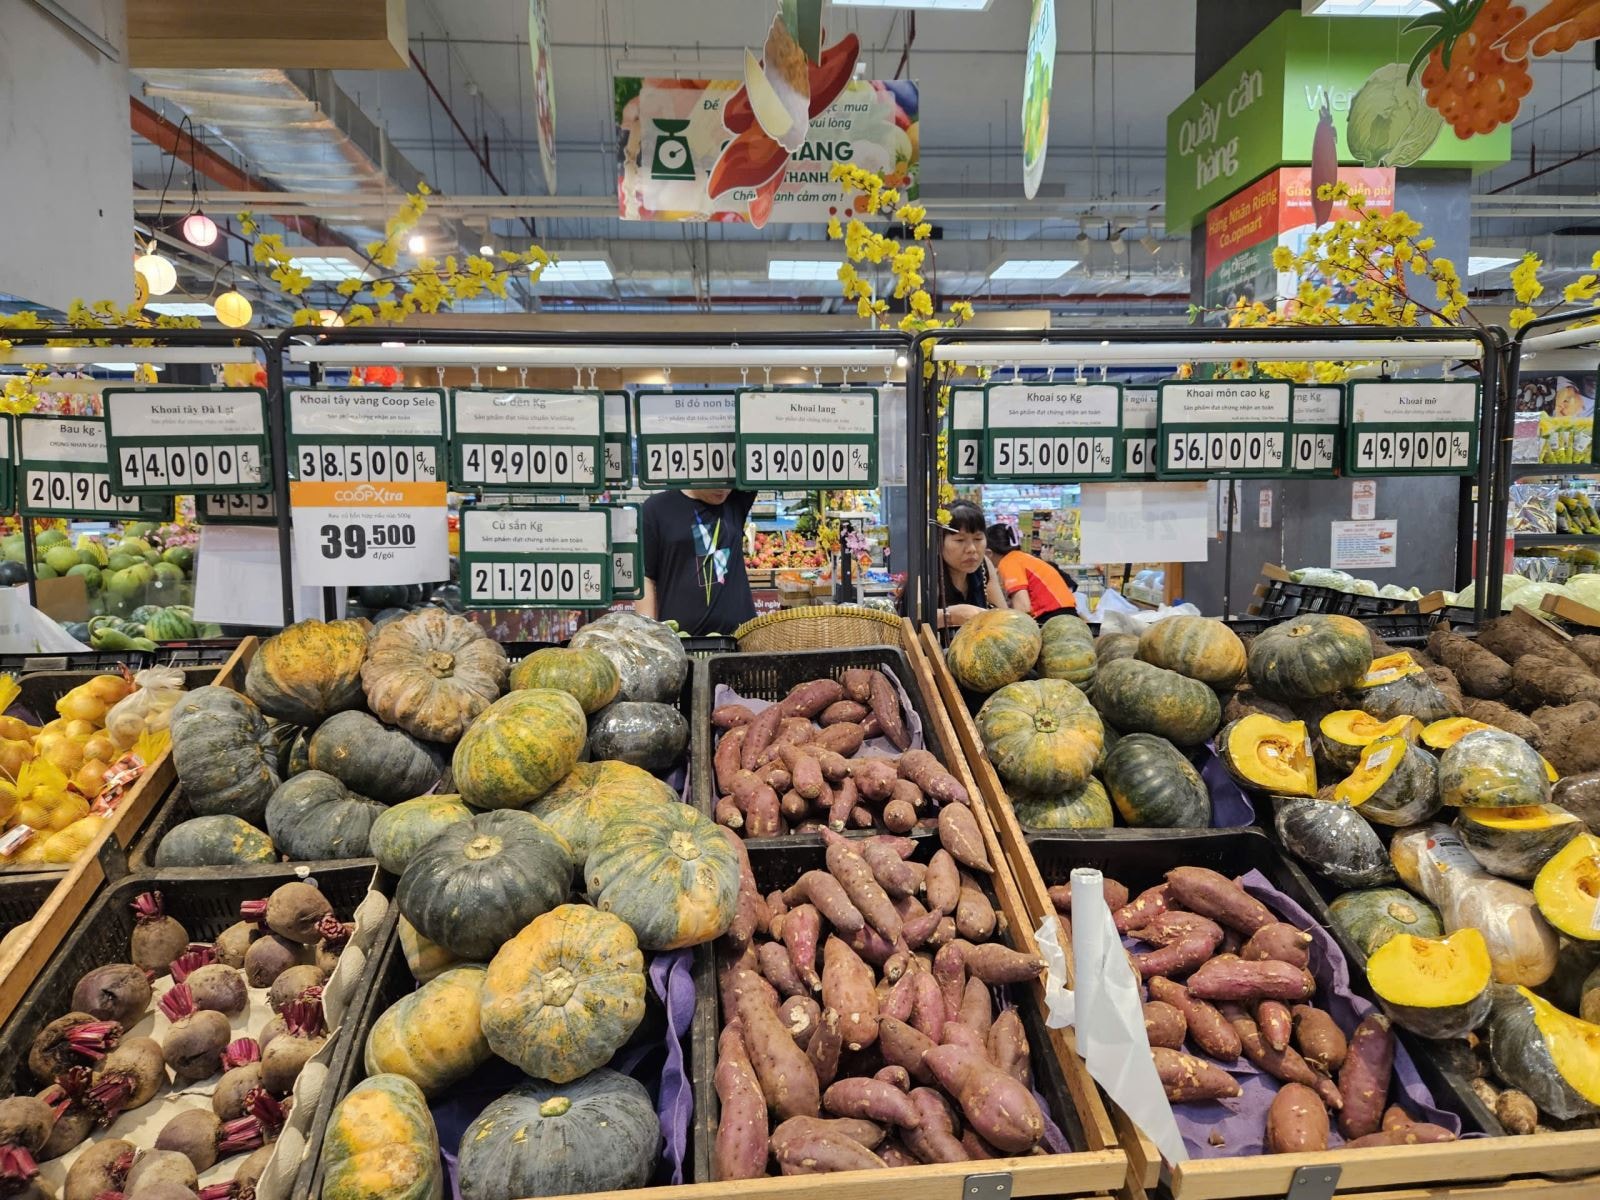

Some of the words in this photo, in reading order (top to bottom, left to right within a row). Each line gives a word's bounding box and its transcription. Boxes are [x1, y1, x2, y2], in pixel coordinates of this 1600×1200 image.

[843, 103, 869, 112] mua
[809, 117, 826, 128] vui
[828, 117, 852, 130] lòng
[1196, 136, 1240, 190] hàng
[733, 190, 756, 201] Châ
[797, 190, 819, 201] cảm
[821, 192, 837, 201] ơn
[1027, 392, 1054, 401] Khoai
[1056, 394, 1067, 403] sọ
[1070, 392, 1082, 403] Kg
[1186, 389, 1214, 398] Khoai
[1240, 390, 1257, 398] cao
[1259, 388, 1270, 399] kg
[1310, 392, 1321, 402] Kg
[300, 395, 331, 405] Khoai
[333, 395, 350, 406] tây
[353, 395, 379, 407] vàng
[381, 396, 410, 408] Coop
[533, 398, 547, 409] Kg
[703, 400, 722, 408] non
[1399, 397, 1422, 405] Khoai
[151, 405, 181, 414] Khoai
[183, 405, 198, 415] tây
[201, 404, 215, 414] Đà
[790, 403, 816, 412] Khoai
[818, 404, 836, 413] lang
[83, 424, 95, 436] kg
[999, 442, 1089, 466] 55.000
[1095, 443, 1110, 465] đ/kg
[1173, 437, 1261, 461] 56.000
[1266, 437, 1282, 460] đ/kg
[1300, 439, 1312, 461] 0
[1362, 436, 1447, 460] 49.900
[1452, 436, 1467, 459] đ/kg
[467, 448, 568, 475] 49.900
[751, 449, 844, 473] 39.000
[964, 444, 975, 467] 2
[124, 450, 232, 478] 44.000
[302, 451, 409, 476] 38.500
[416, 451, 436, 475] đ/kg
[530, 520, 543, 532] Kg
[320, 524, 416, 559] 39.500
[372, 551, 394, 560] đ/gói
[615, 557, 632, 578] đ/kg
[476, 568, 574, 592] 21.200
